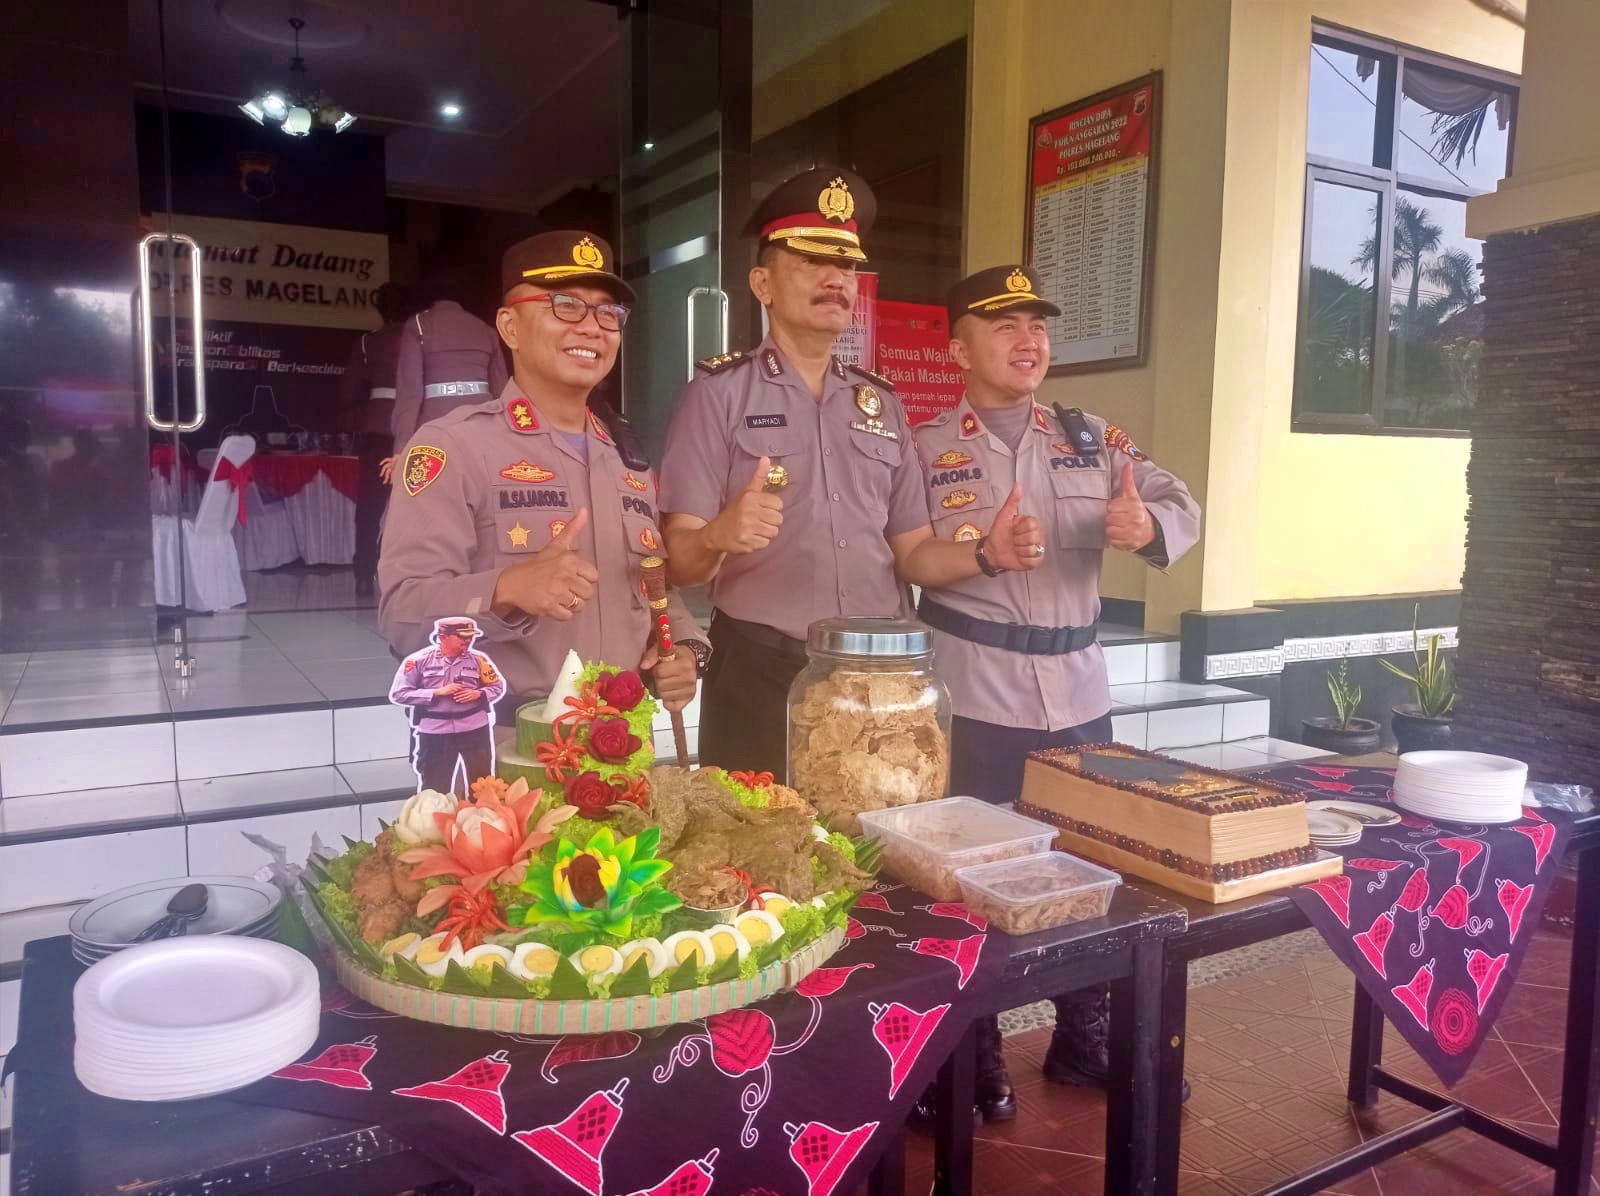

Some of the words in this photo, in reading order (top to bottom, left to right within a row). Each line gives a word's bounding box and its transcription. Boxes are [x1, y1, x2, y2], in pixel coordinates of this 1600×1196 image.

[1084, 132, 1120, 152] MAGELANG
[272, 243, 375, 280] Datang
[879, 344, 920, 361] Semua
[922, 347, 956, 366] Wajib
[883, 366, 915, 382] Pakai
[752, 417, 781, 426] MARYADI
